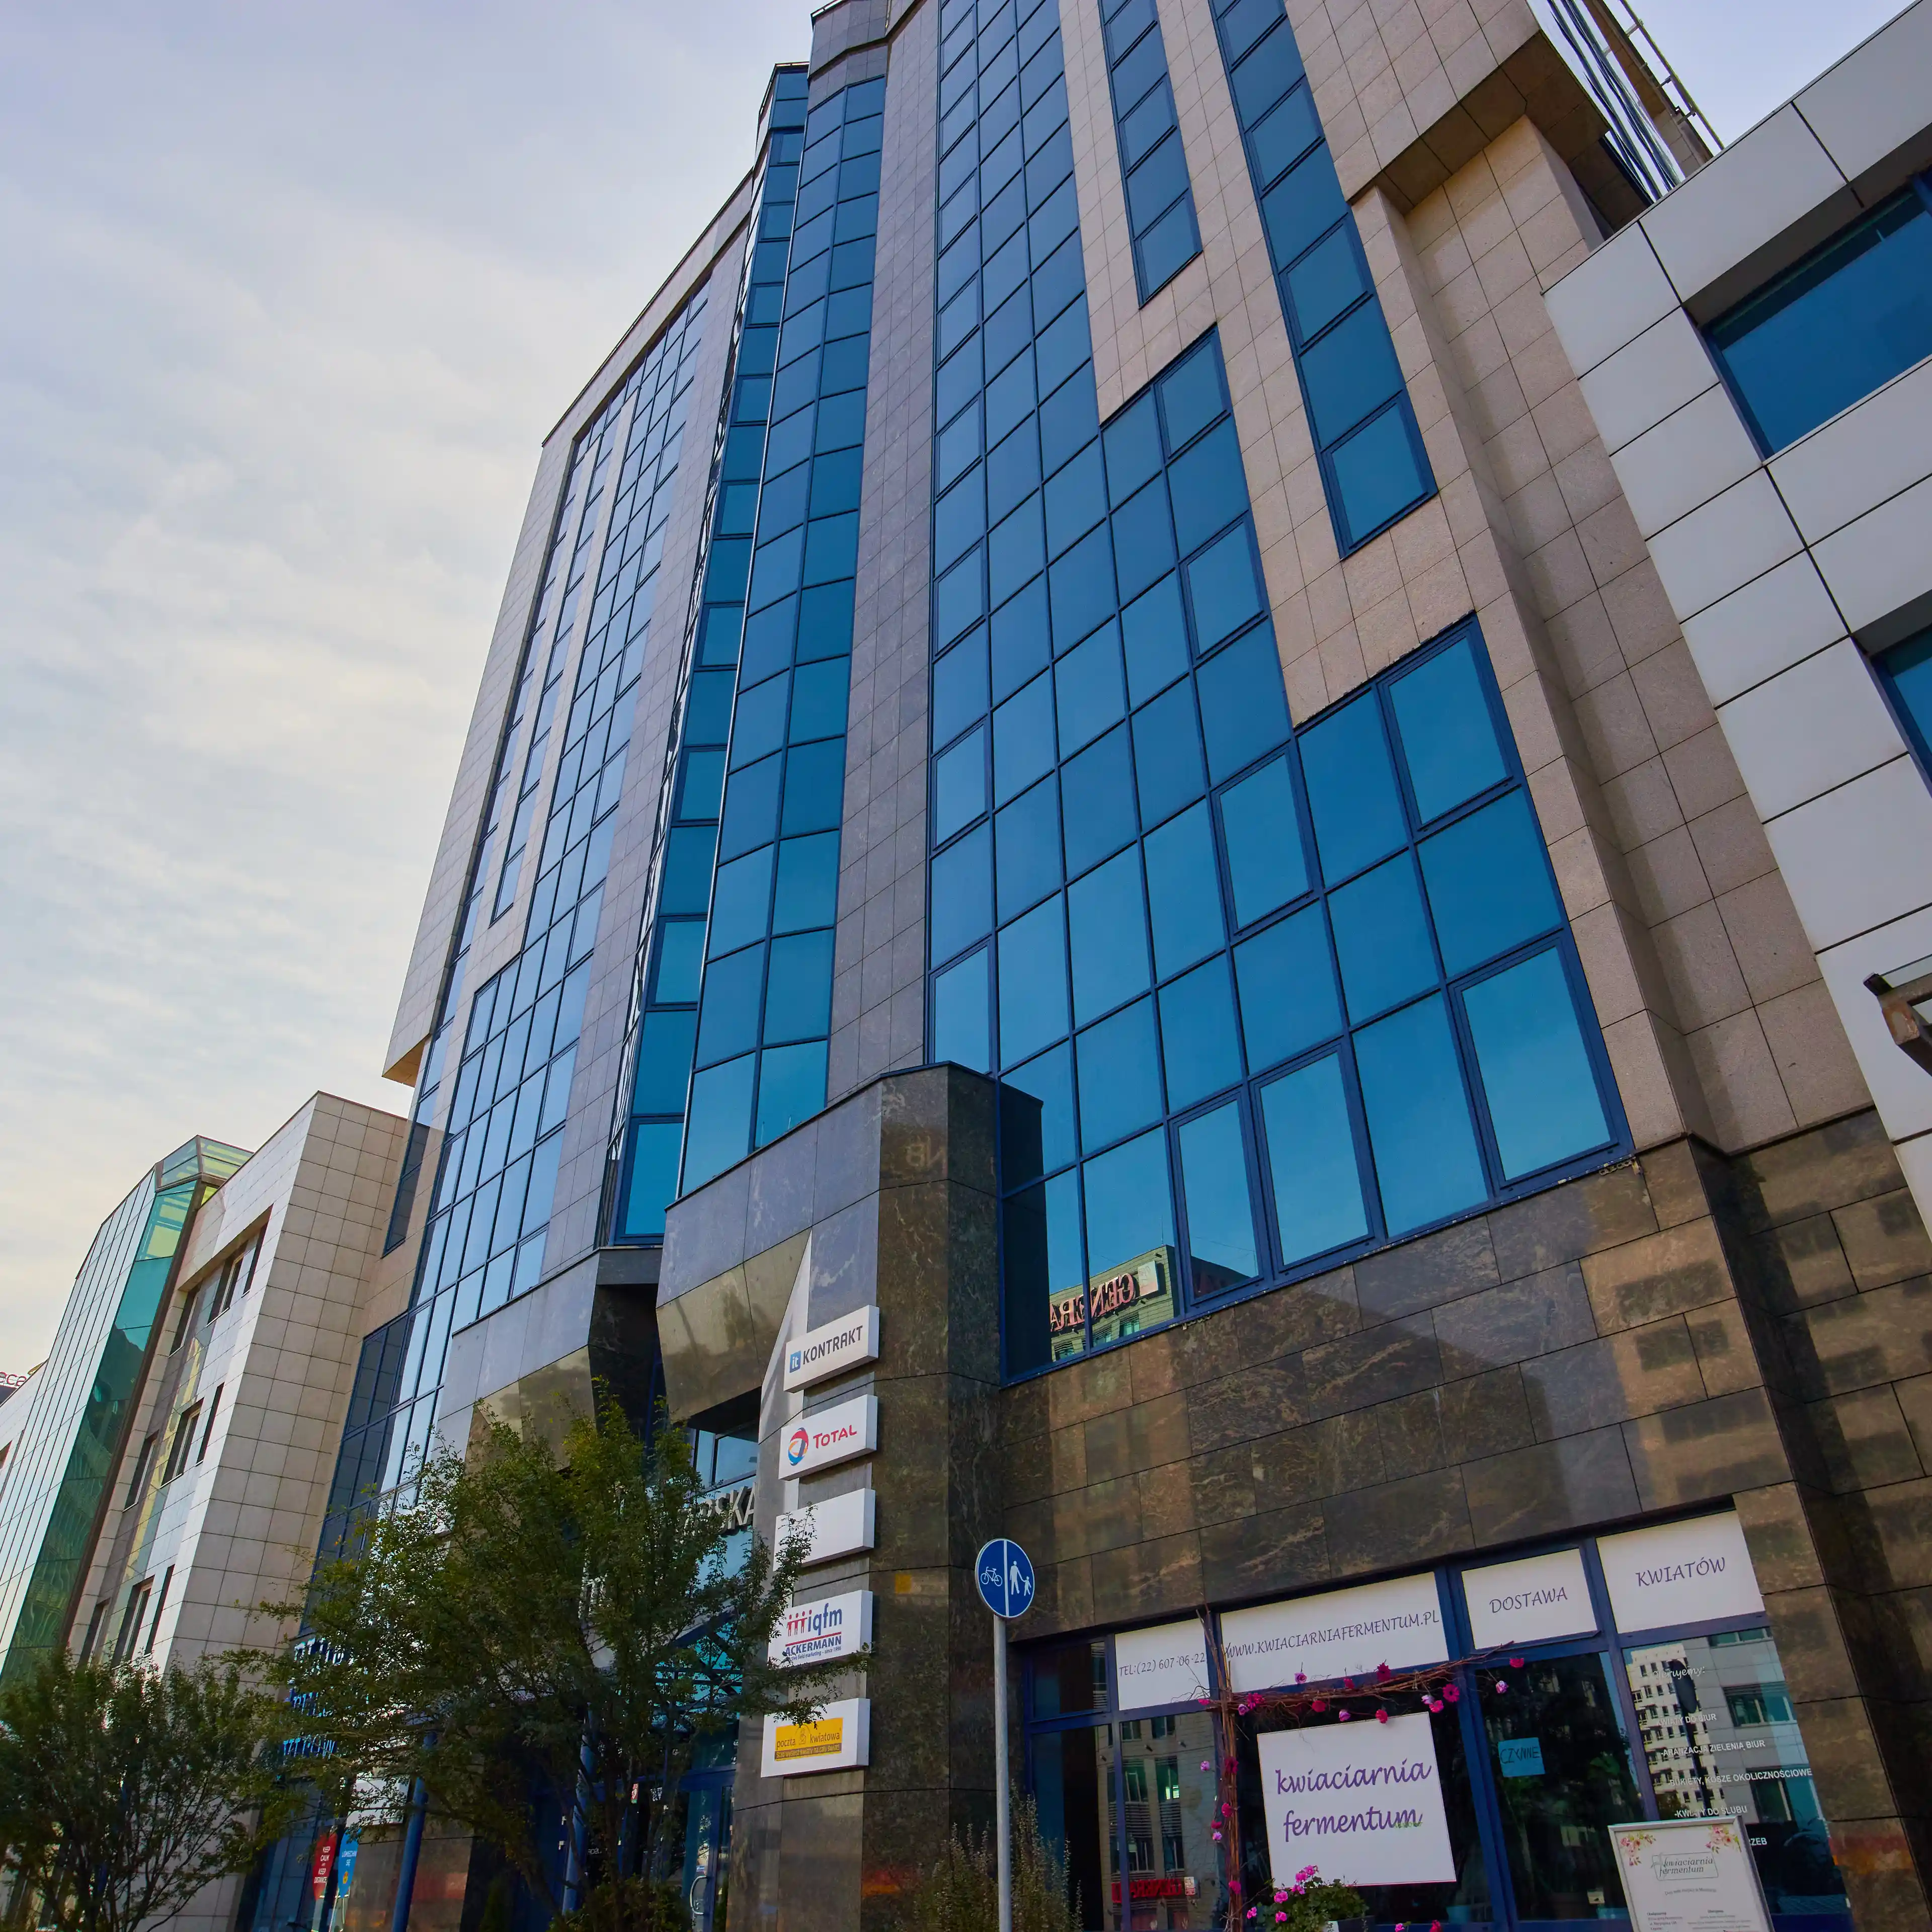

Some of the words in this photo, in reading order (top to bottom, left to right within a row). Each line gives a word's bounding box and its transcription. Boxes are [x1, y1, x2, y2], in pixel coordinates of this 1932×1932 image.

[803, 1325, 863, 1364] KONTRAKT
[813, 1425, 857, 1448] TOTAL
[1635, 1557, 1725, 1587] KWIATÓW
[1489, 1586, 1568, 1614] DOSTAWA
[1226, 1610, 1439, 1658] WWW.KWIACIARNIAFERMENTUM.PL
[785, 1635, 842, 1656] ACKERMANN
[1698, 1713, 1717, 1722] BIUR
[776, 1737, 795, 1750] poczta
[810, 1732, 840, 1743] kwiatowa
[1745, 1740, 1765, 1749] BIUR
[1500, 1746, 1540, 1764] CZYNNE
[1275, 1757, 1432, 1795] kwiaciarnia
[1705, 1775, 1732, 1785] KOSZE
[1733, 1768, 1812, 1782] OKOLICZNOŚCIOWE
[1721, 1805, 1748, 1814] ŚLUBU
[1283, 1806, 1423, 1842] fermentum
[1659, 1865, 1704, 1877] fermentum
